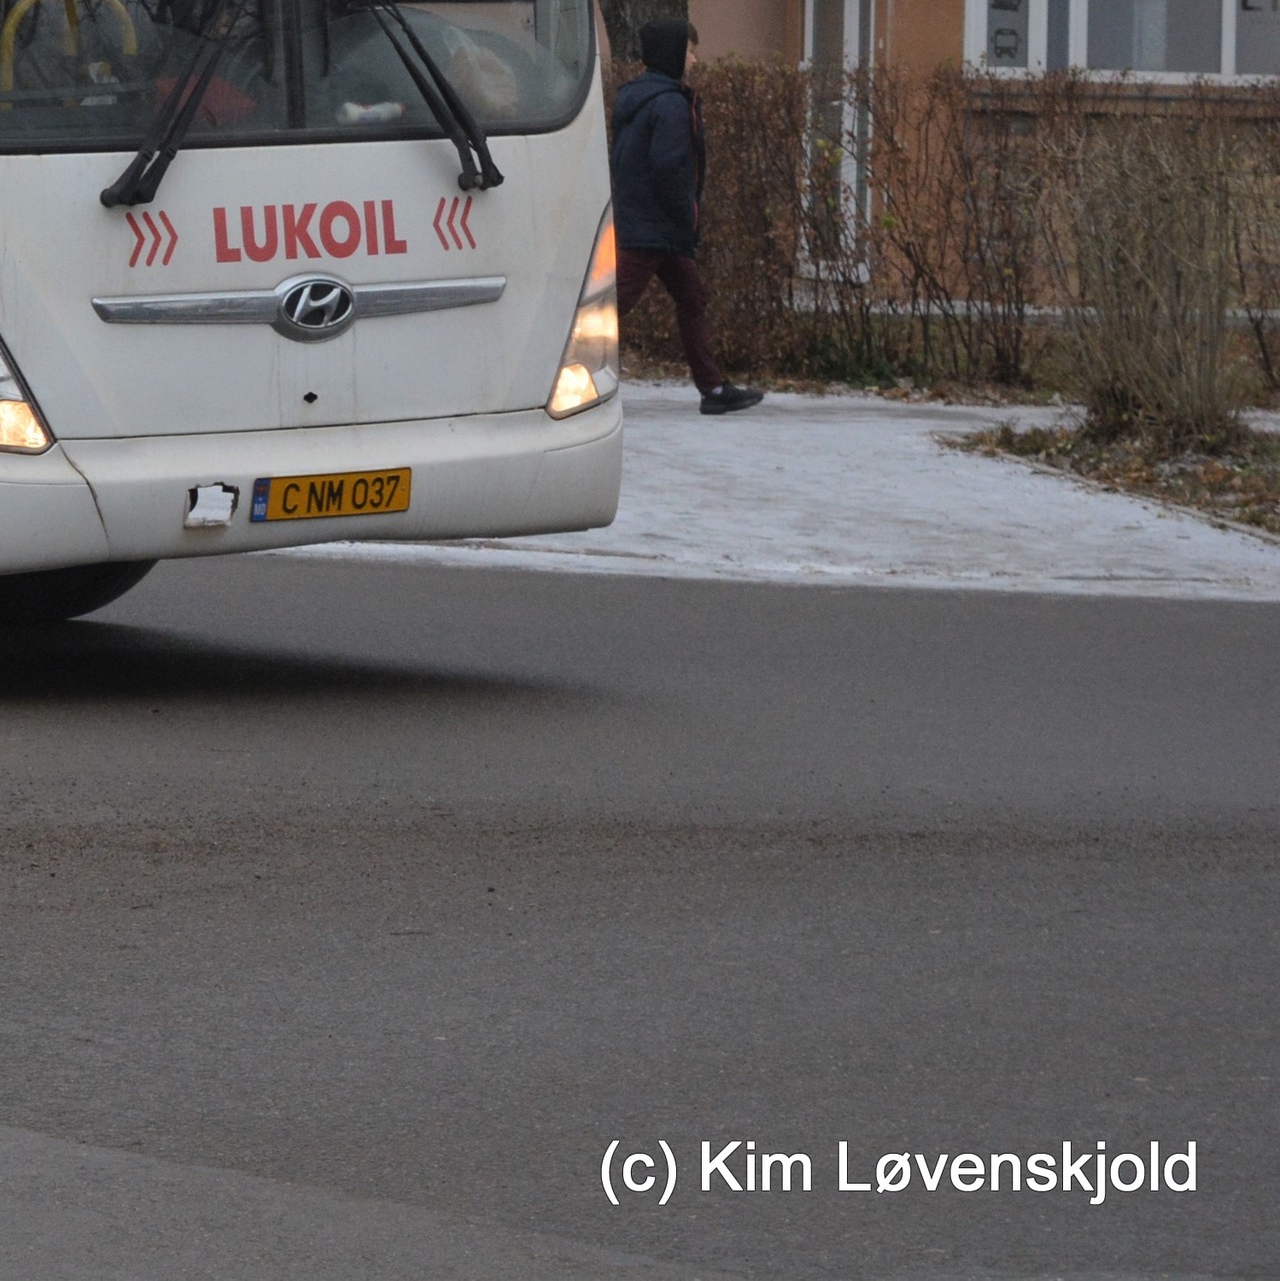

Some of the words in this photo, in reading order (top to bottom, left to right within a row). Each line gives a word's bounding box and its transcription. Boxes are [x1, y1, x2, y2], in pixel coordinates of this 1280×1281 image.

[213, 199, 407, 263] LUKOIL
[282, 483, 301, 514] C
[306, 479, 345, 513] NM
[352, 475, 401, 509] 037
